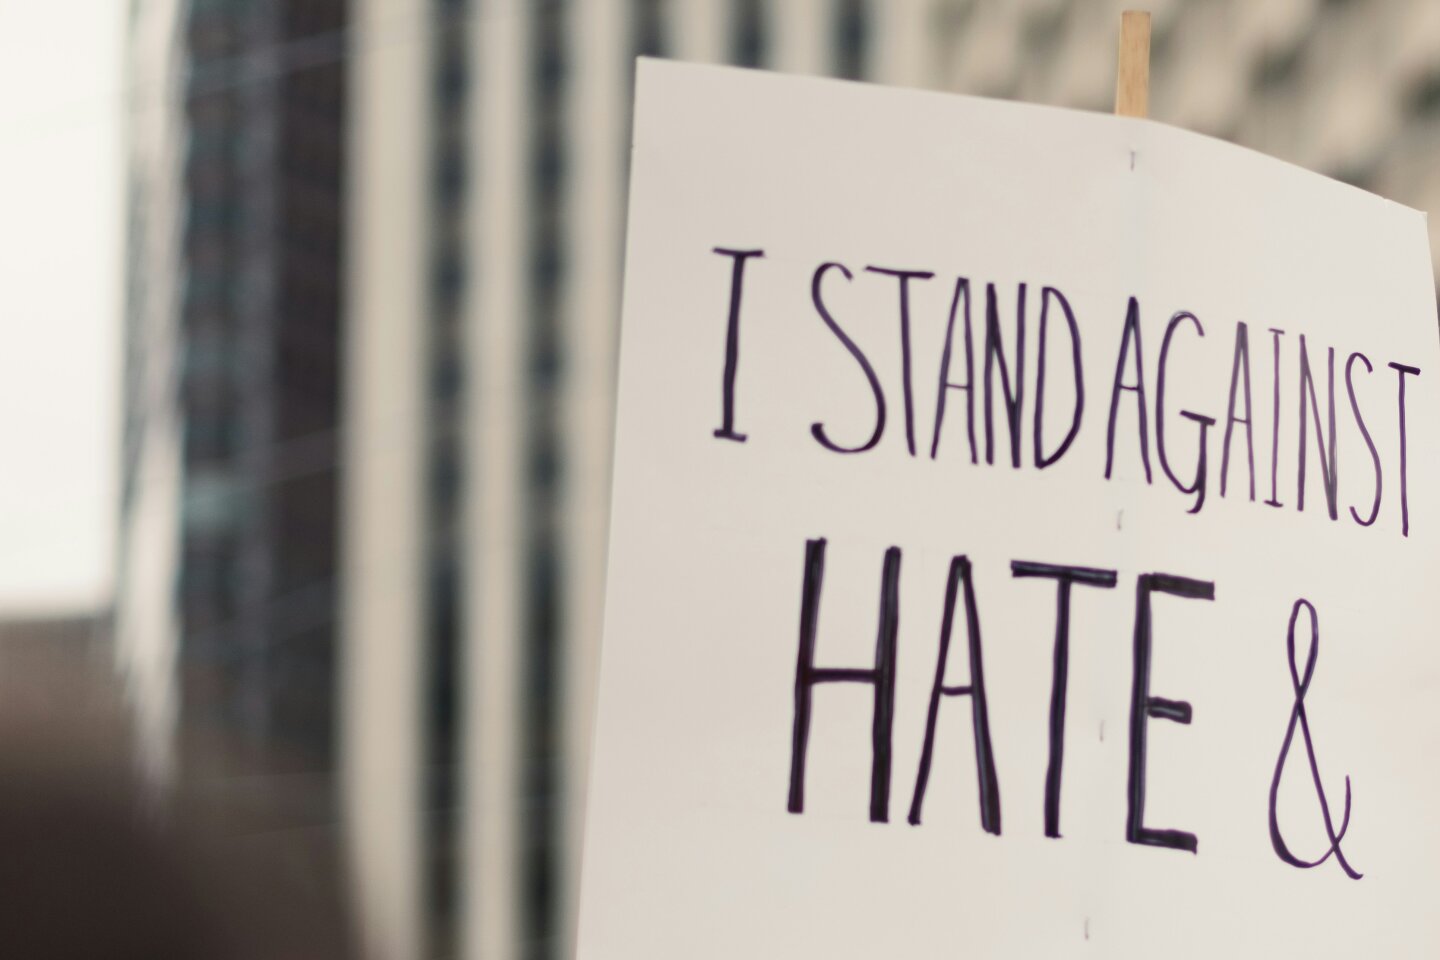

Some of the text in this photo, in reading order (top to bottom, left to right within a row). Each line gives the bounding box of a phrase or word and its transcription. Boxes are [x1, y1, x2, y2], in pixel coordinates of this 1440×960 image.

[712, 247, 1420, 537] I STAND AGAINST
[787, 538, 1363, 879] HATE &
